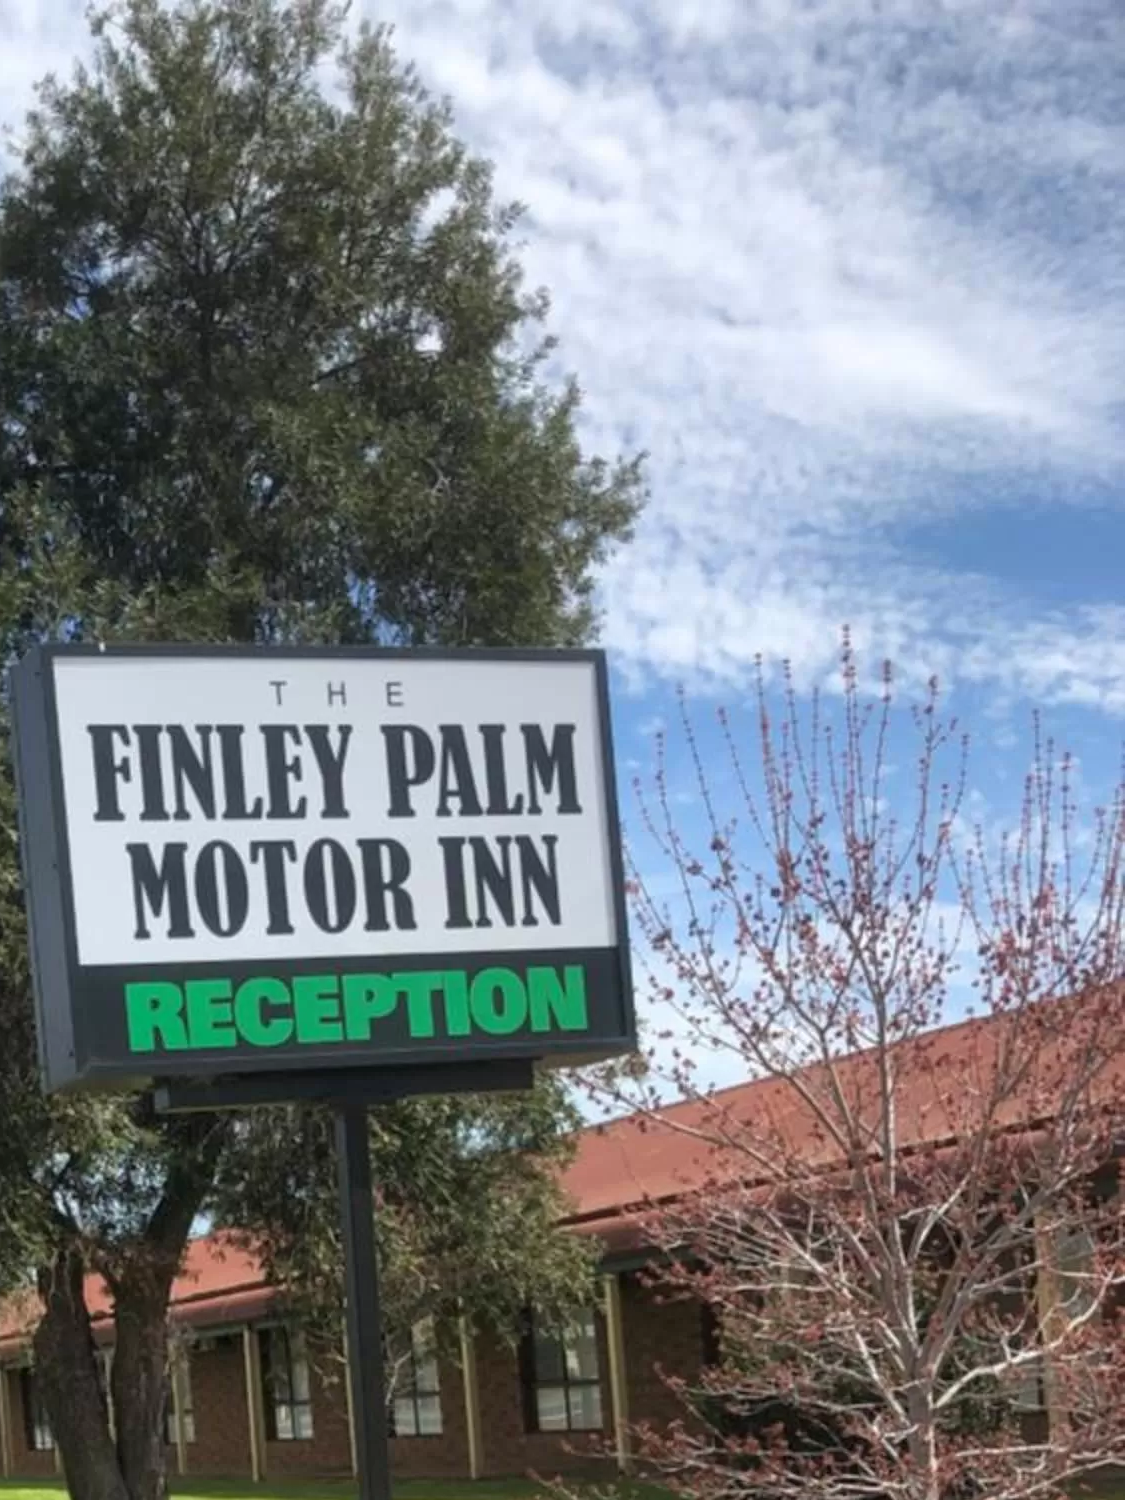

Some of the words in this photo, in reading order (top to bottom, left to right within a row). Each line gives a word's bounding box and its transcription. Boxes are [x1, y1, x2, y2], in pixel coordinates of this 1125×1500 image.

[269, 681, 406, 706] THE
[86, 724, 353, 822] FINLEY
[380, 723, 583, 818] PALM
[125, 837, 418, 940] MOTOR
[437, 834, 562, 929] INN
[124, 965, 588, 1053] RECEPTION
